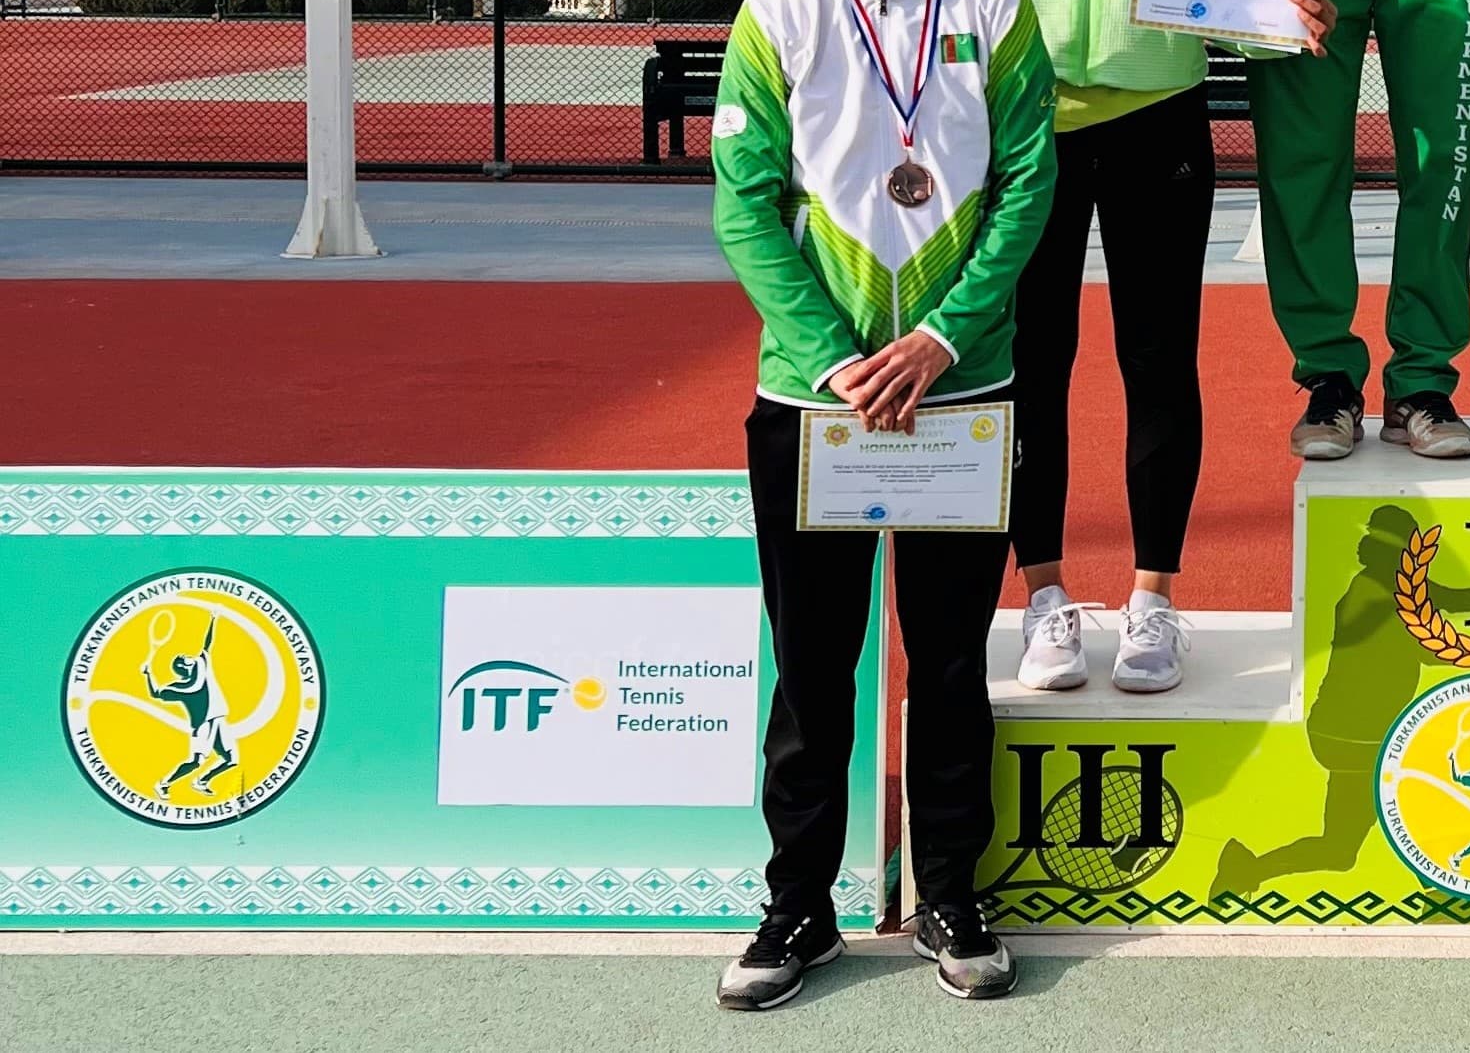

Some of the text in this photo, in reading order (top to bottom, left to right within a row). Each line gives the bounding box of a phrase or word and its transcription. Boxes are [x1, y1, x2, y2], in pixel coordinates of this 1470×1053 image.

[858, 441, 959, 454] HORMAT HATY
[187, 577, 245, 596] TENNIS
[617, 659, 753, 678] International
[618, 687, 685, 704] Tennis
[461, 687, 560, 732] ITF
[616, 714, 728, 732] Federation
[77, 727, 310, 820] TURKMENISTAN TENNIS FEDERATION
[1005, 744, 1178, 849] III
[1385, 798, 1459, 886] TURKMENISTAN
